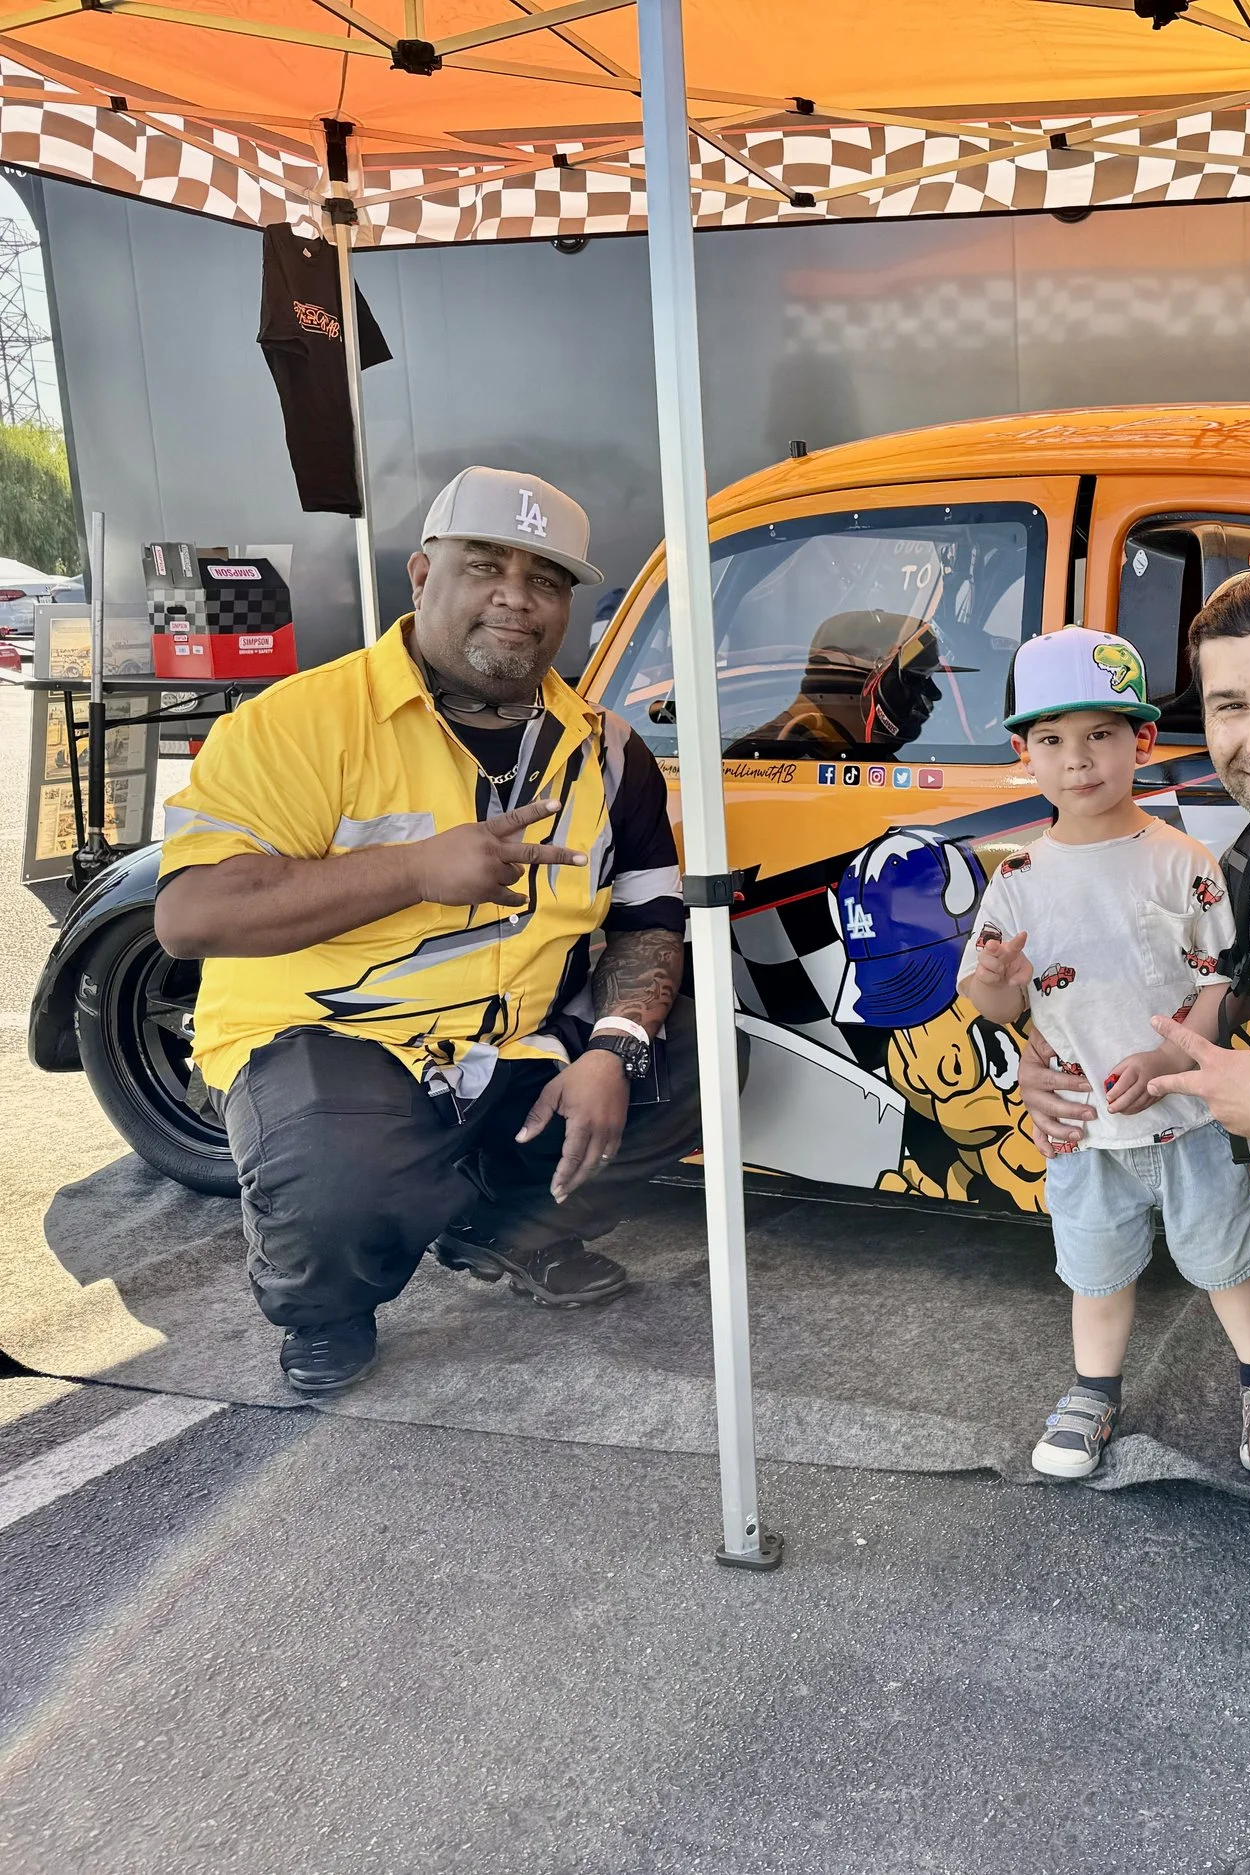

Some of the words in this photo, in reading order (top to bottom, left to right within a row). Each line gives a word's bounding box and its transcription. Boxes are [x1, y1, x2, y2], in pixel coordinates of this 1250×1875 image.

[515, 488, 548, 538] LA
[214, 568, 256, 577] SIMPSON
[242, 637, 270, 647] SIMPSON
[722, 762, 797, 784] rillinwitAB
[844, 896, 877, 940] LA
